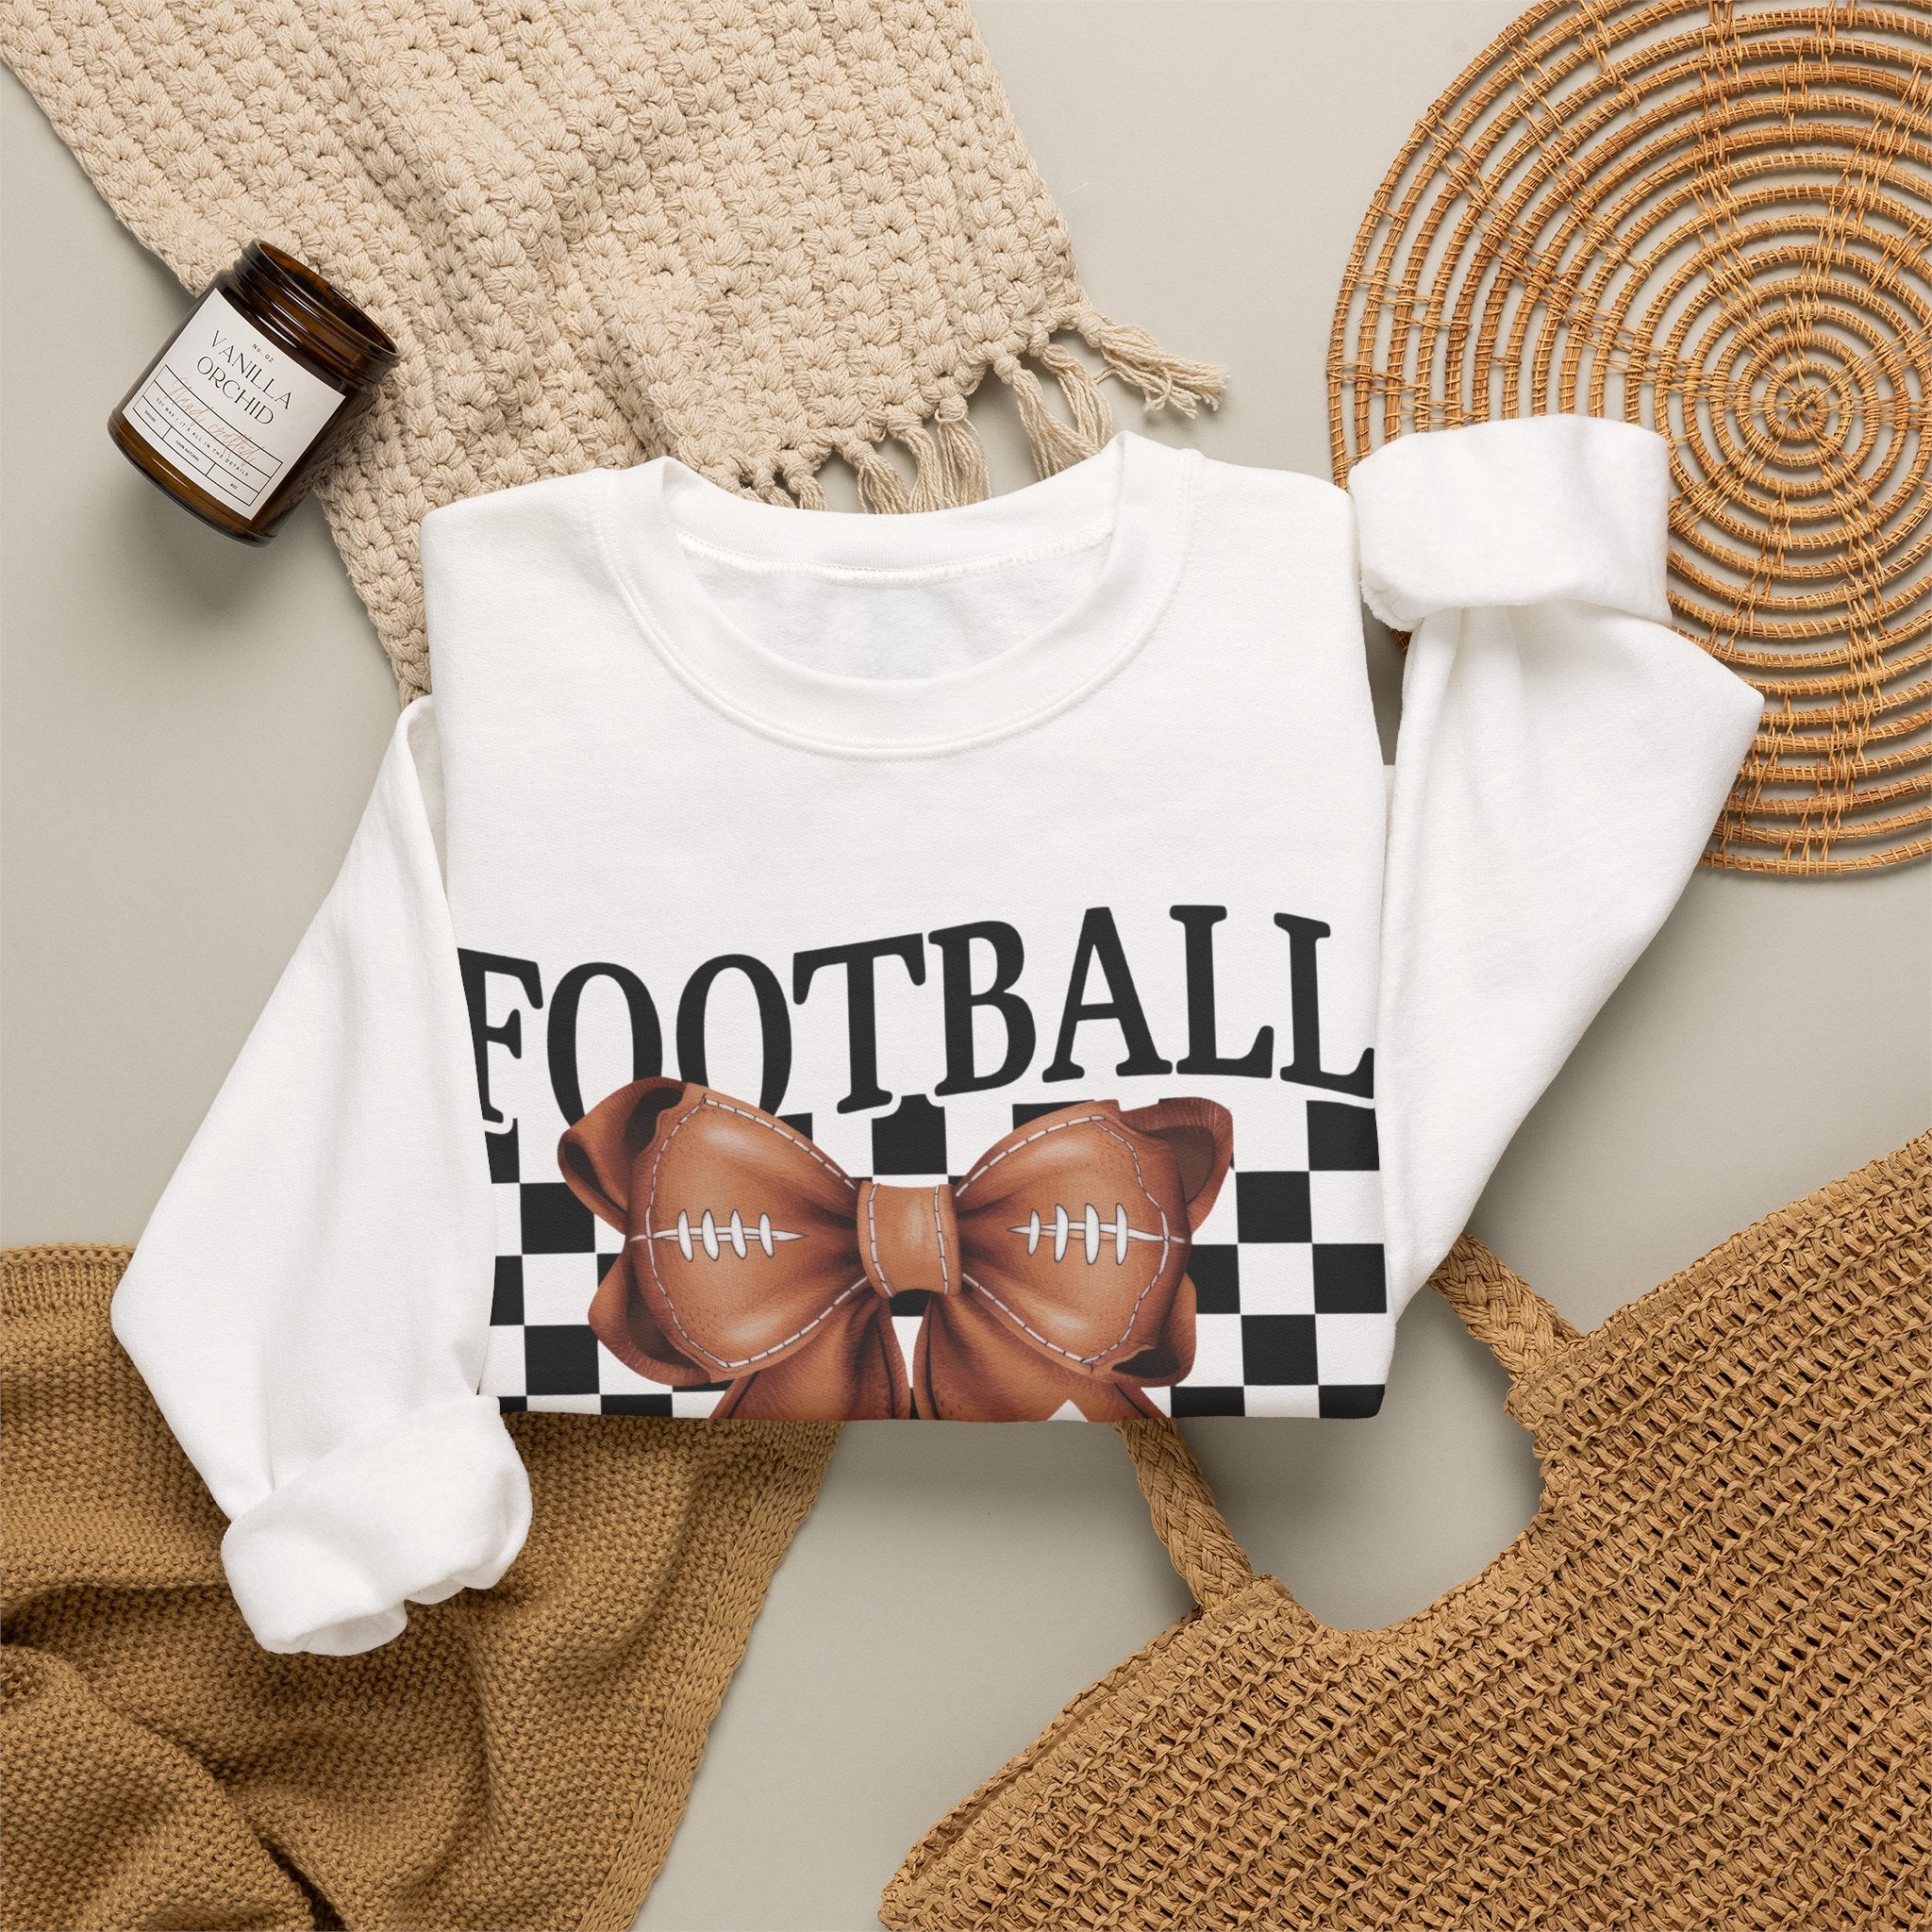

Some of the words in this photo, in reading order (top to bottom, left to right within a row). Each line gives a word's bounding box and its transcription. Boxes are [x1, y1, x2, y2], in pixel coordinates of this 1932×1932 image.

[210, 329, 293, 409] VANILLA
[251, 342, 263, 356] No.
[264, 354, 275, 364] 02
[196, 356, 275, 425] ORCHID
[192, 432, 203, 442] ALL
[212, 448, 224, 458] THE
[225, 458, 249, 477] DETAILS
[457, 904, 1374, 1127] FOOTBALL
